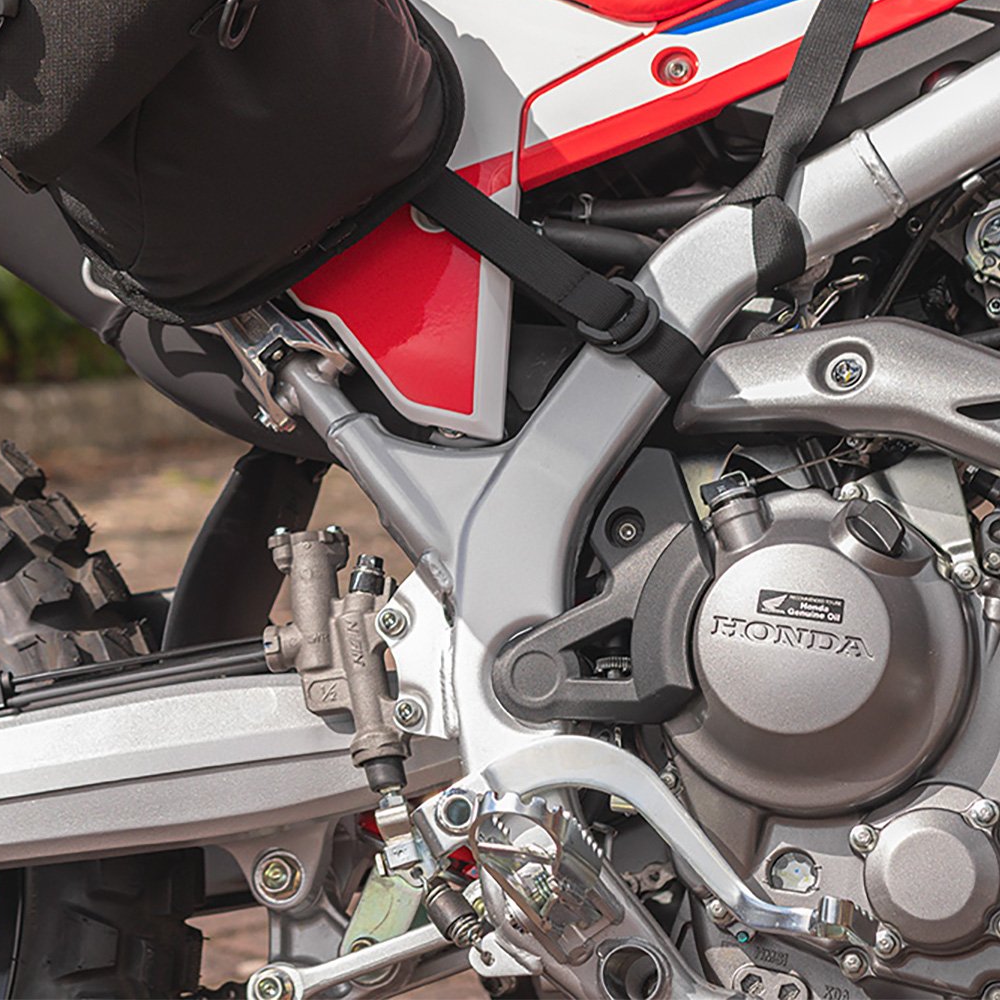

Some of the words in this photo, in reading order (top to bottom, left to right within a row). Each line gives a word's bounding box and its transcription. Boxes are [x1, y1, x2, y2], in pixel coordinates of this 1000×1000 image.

[787, 607, 825, 620] Genuine
[826, 612, 841, 622] Oil
[800, 602, 829, 613] Honda
[711, 615, 875, 661] HONDA
